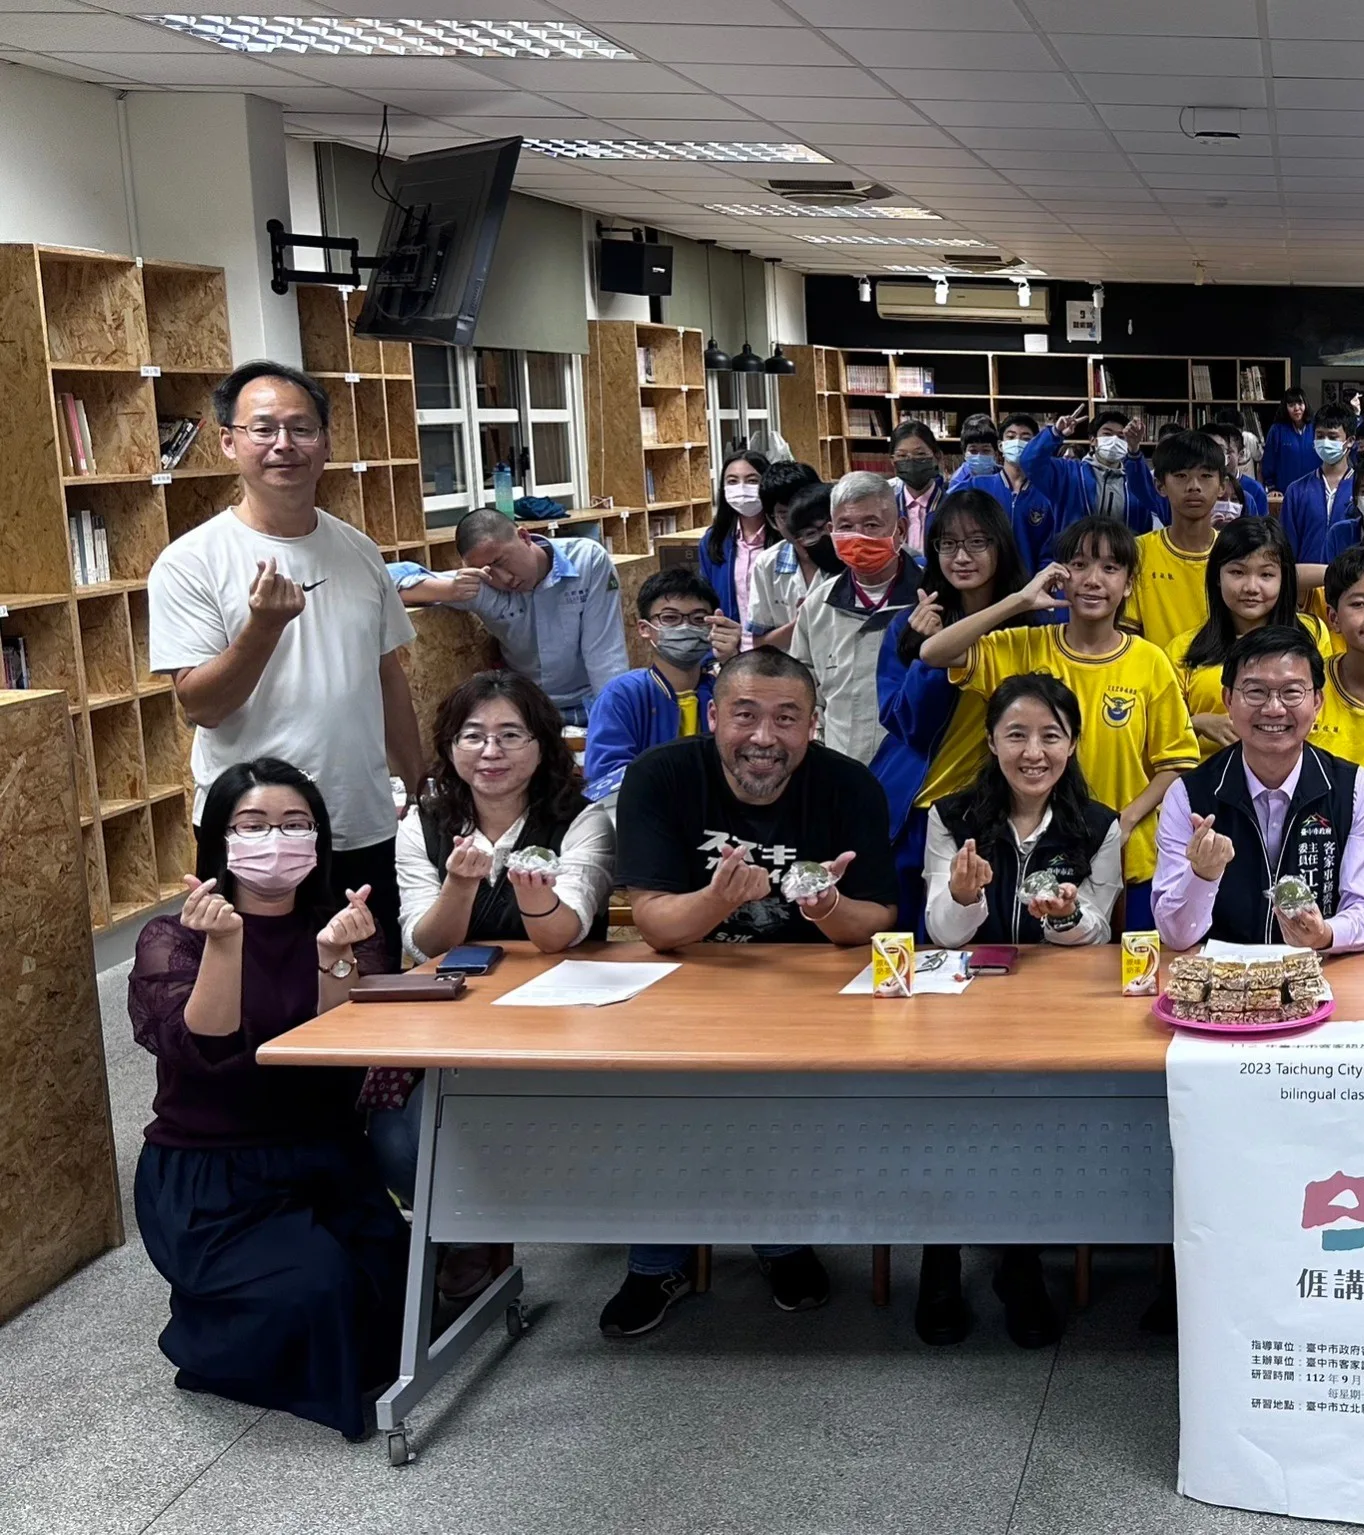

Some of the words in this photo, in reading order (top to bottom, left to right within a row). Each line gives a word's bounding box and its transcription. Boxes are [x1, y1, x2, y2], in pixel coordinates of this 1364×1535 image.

[1239, 1062, 1271, 1075] 2023
[1276, 1062, 1334, 1079] Taichung
[1337, 1063, 1363, 1079] City
[1280, 1087, 1336, 1103] bilingual
